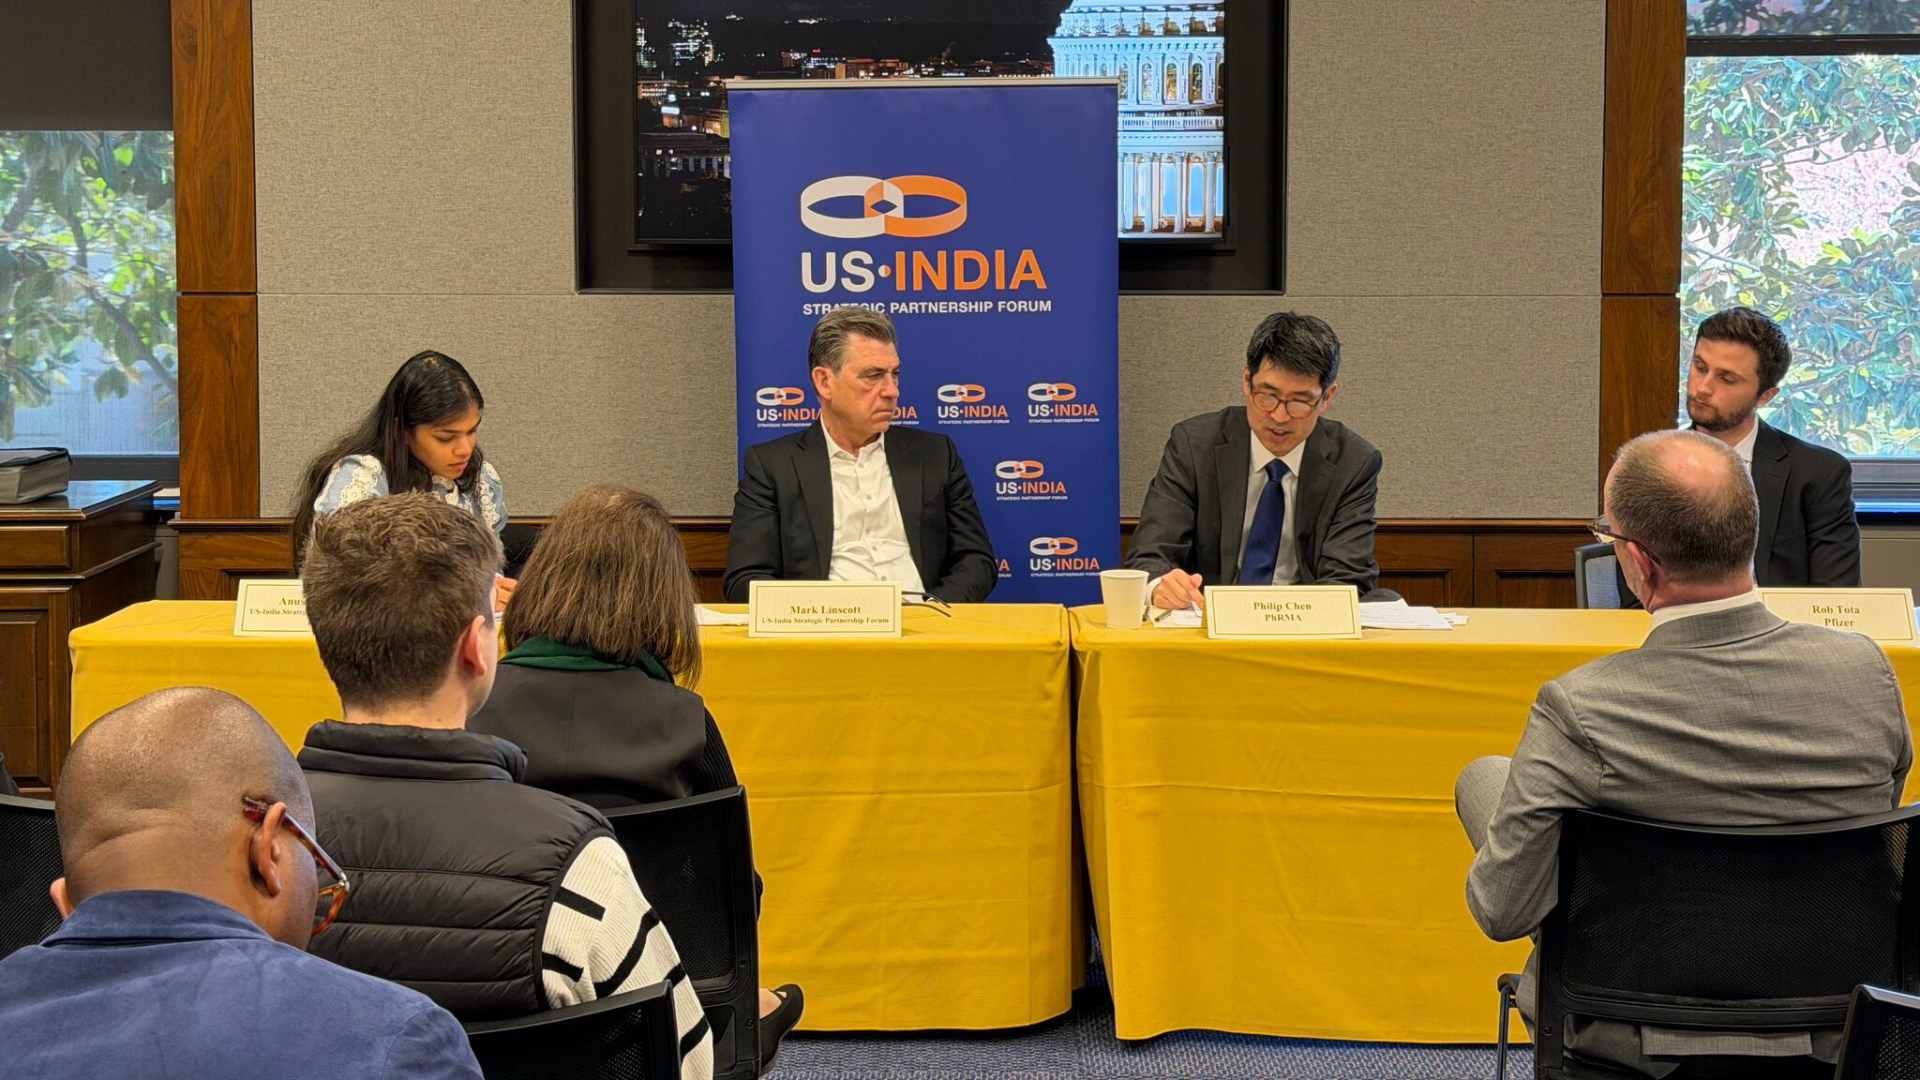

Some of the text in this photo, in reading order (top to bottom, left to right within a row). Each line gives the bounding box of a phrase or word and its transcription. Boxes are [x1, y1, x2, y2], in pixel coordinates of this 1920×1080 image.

[803, 300, 1053, 316] STRIC PARTNERSHIP FORUM
[790, 605, 861, 614] Mark Linscott
[1253, 602, 1312, 612] Philip Chen
[1812, 605, 1860, 614] Rob Tota
[793, 617, 823, 625] Strategic
[825, 617, 865, 625] Partnership
[1265, 614, 1303, 622] PhRMA
[1824, 618, 1854, 627] Pfizer
